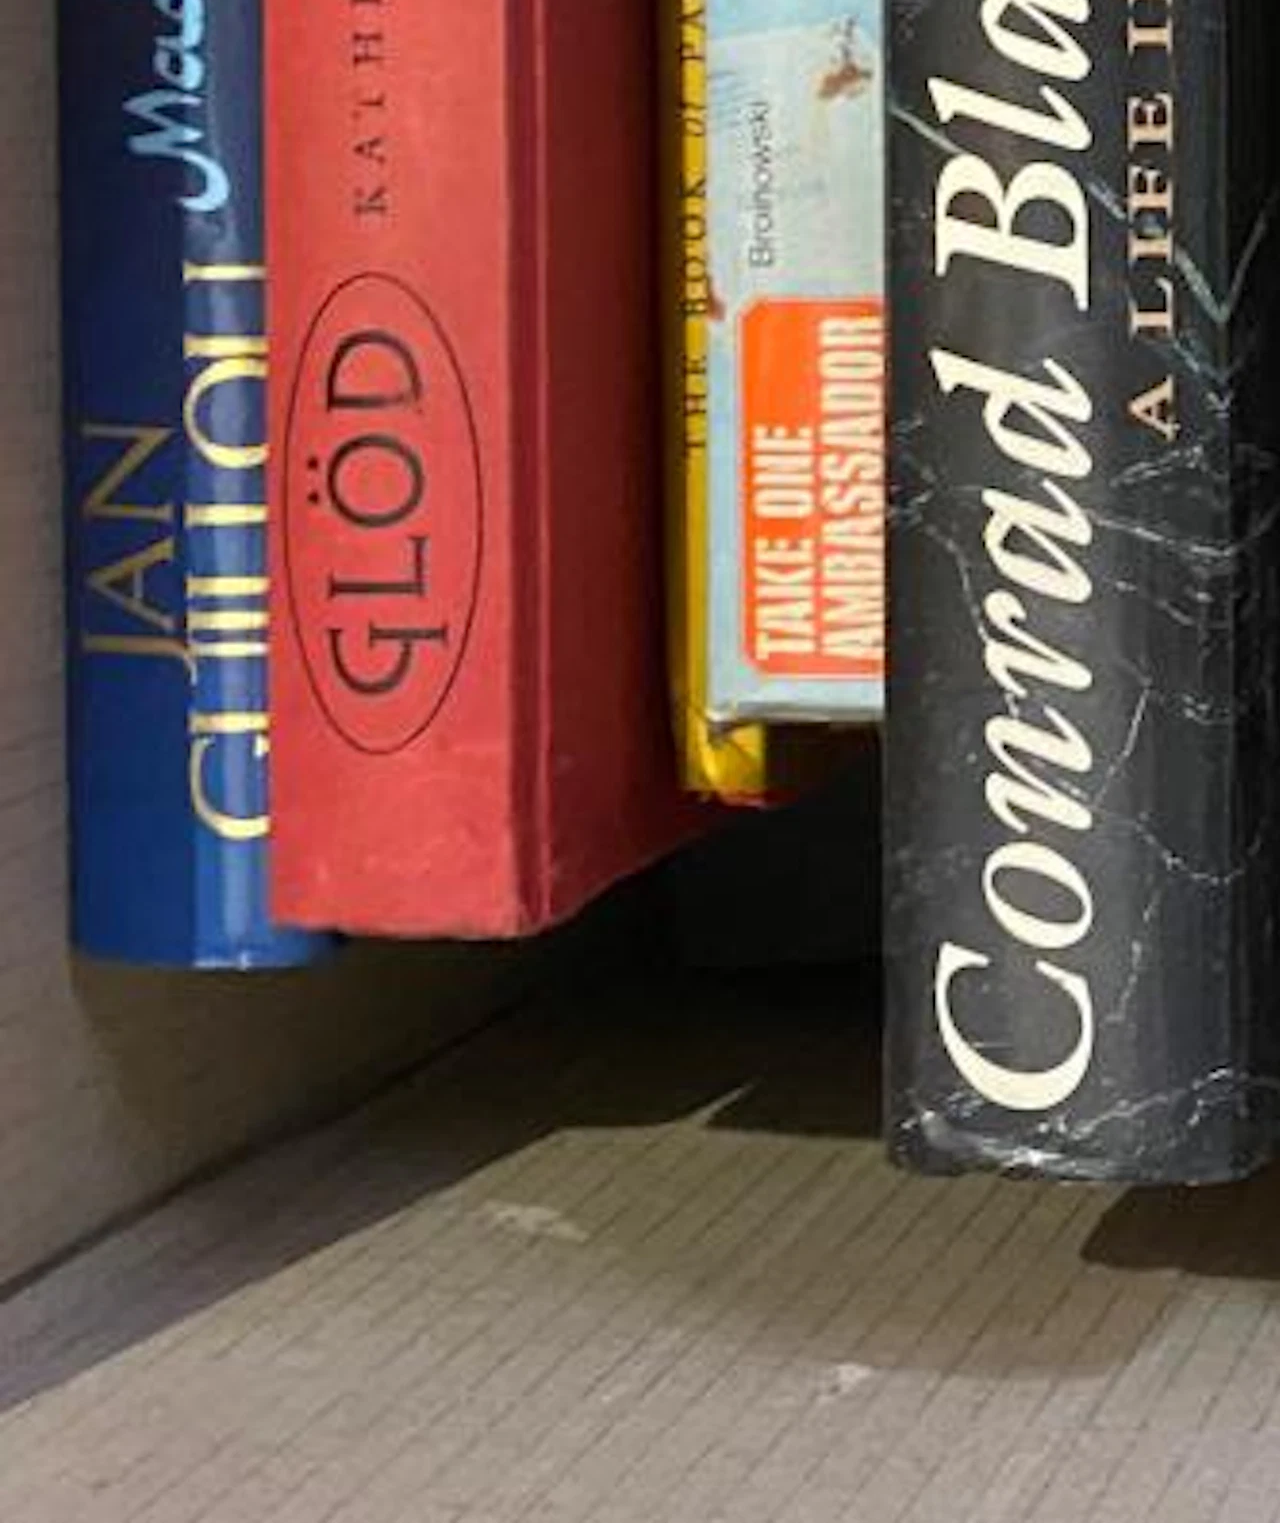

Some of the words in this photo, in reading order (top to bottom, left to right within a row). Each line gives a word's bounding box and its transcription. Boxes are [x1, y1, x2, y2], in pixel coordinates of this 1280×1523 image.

[1126, 91, 1176, 339] LIFE
[306, 328, 448, 695] GLÖD
[752, 424, 815, 521] ONE
[815, 315, 884, 661] AMBASSADOR
[1128, 374, 1181, 442] A
[81, 422, 197, 686] JAN
[754, 535, 816, 661] TAKE
[929, 347, 1093, 1113] Conrad
